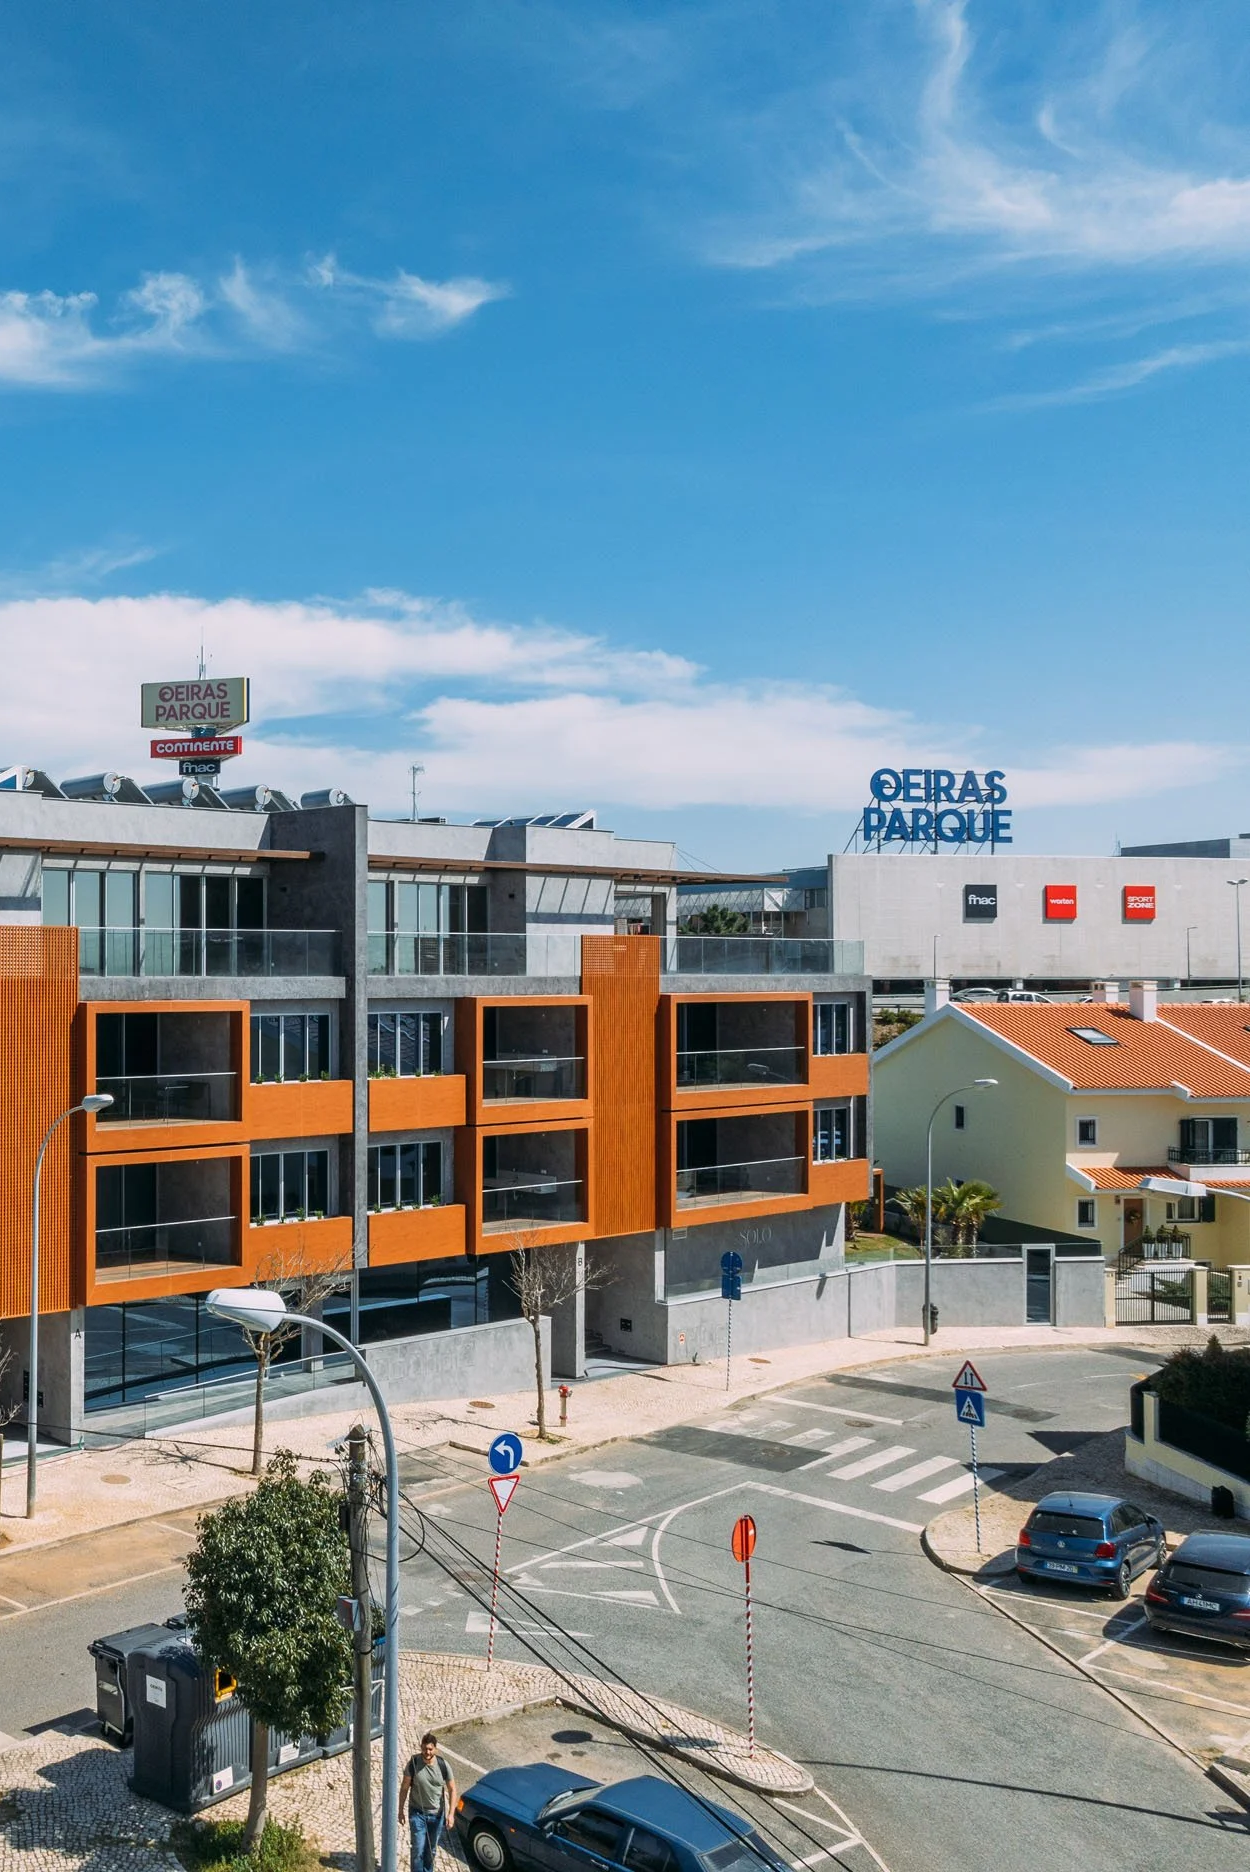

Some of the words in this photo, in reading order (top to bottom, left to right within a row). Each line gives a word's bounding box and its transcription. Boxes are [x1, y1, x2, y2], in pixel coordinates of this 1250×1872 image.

[158, 682, 228, 703] OEIRAS
[155, 701, 231, 721] PARQUE
[156, 740, 234, 753] CONTINENTE
[182, 761, 216, 773] fnac
[870, 768, 1007, 805] OEIRAS
[863, 807, 1013, 843] PARQUE
[968, 894, 996, 905] fnac
[1050, 897, 1074, 905] worten
[74, 1328, 82, 1340] A
